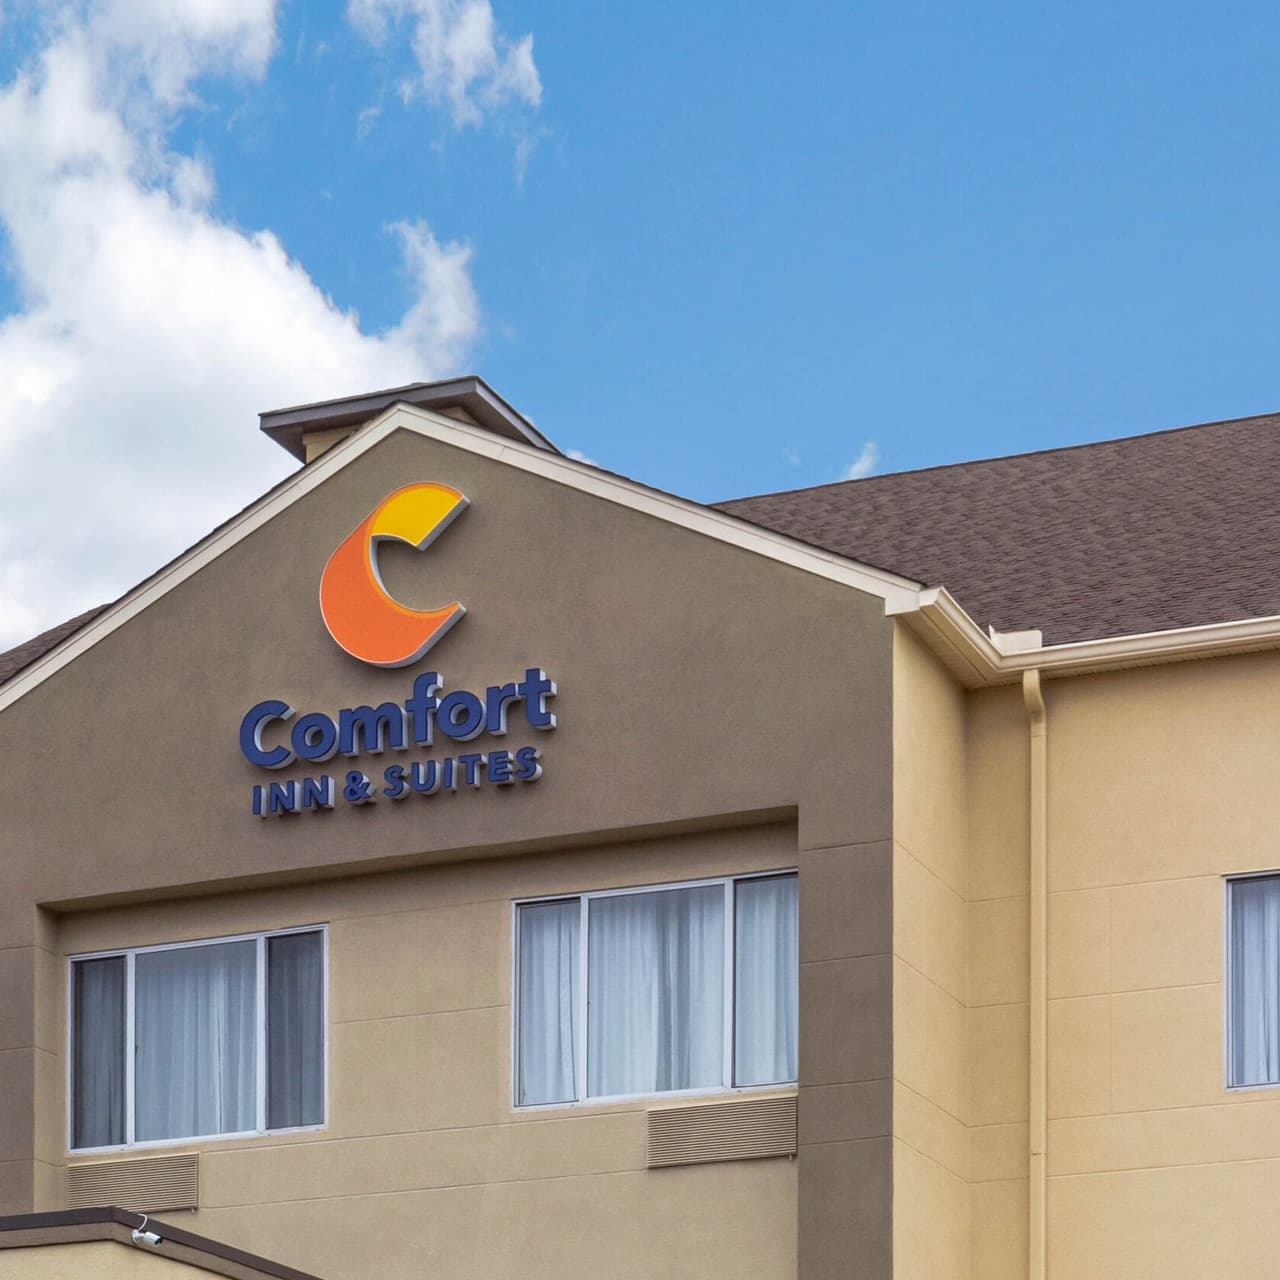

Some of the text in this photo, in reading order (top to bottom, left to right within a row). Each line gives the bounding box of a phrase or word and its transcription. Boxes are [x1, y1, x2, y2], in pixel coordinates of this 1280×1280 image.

[239, 668, 558, 769] Comfort
[252, 746, 543, 818] INN & SUITES
